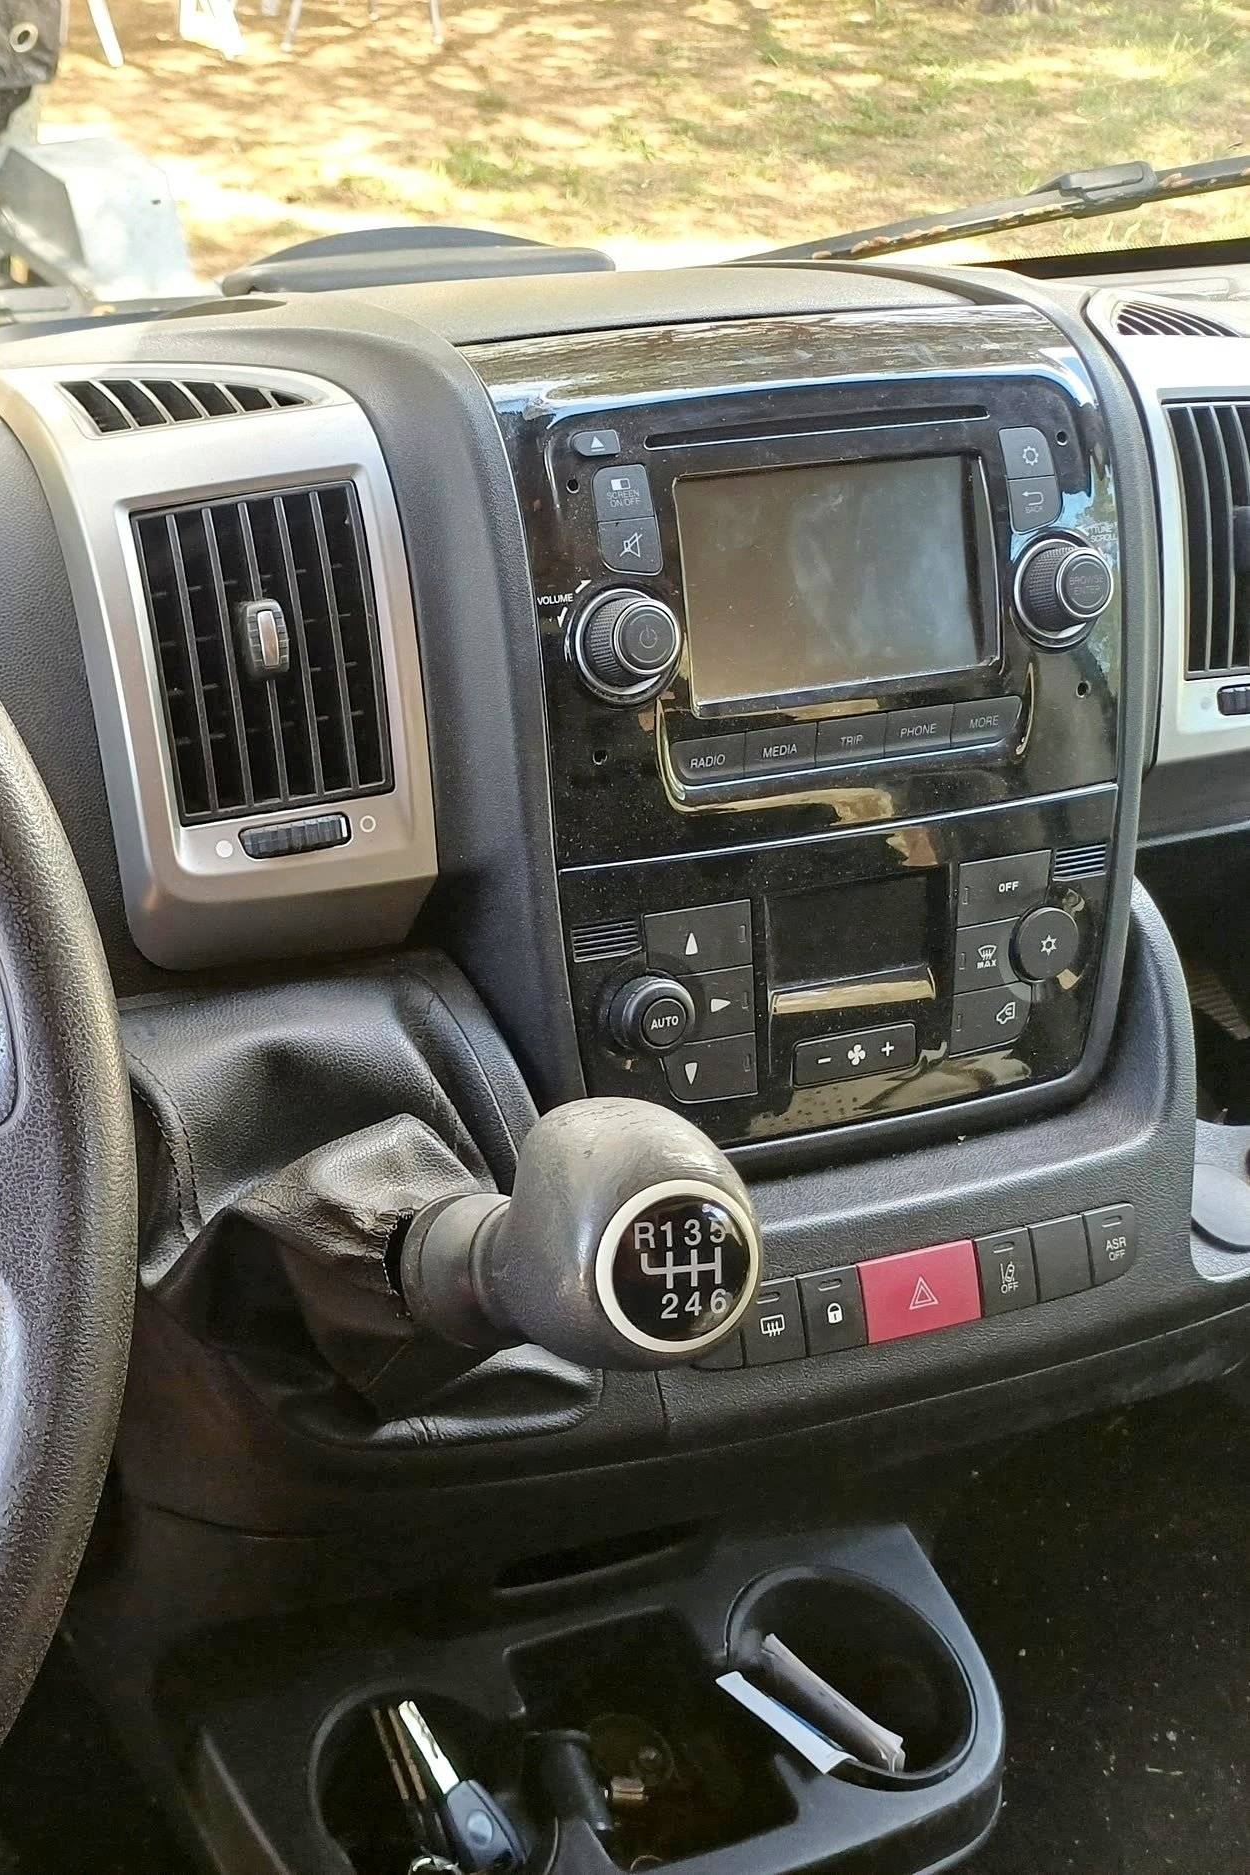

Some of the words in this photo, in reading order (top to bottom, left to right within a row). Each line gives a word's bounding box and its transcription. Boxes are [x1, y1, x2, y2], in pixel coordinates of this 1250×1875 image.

[606, 489, 640, 500] SCREEN
[537, 593, 574, 606] VOLUME
[968, 715, 999, 729] MORE
[900, 723, 937, 738] PHONE
[840, 734, 864, 747] TRIP
[762, 743, 798, 758] MEDIA
[690, 754, 726, 769] RADIO
[998, 881, 1019, 893] OFF
[976, 959, 997, 969] MAX
[650, 1015, 679, 1030] AUTO
[1105, 1236, 1127, 1251] ASR
[1108, 1250, 1126, 1262] OFF
[1000, 1281, 1020, 1294] OFF
